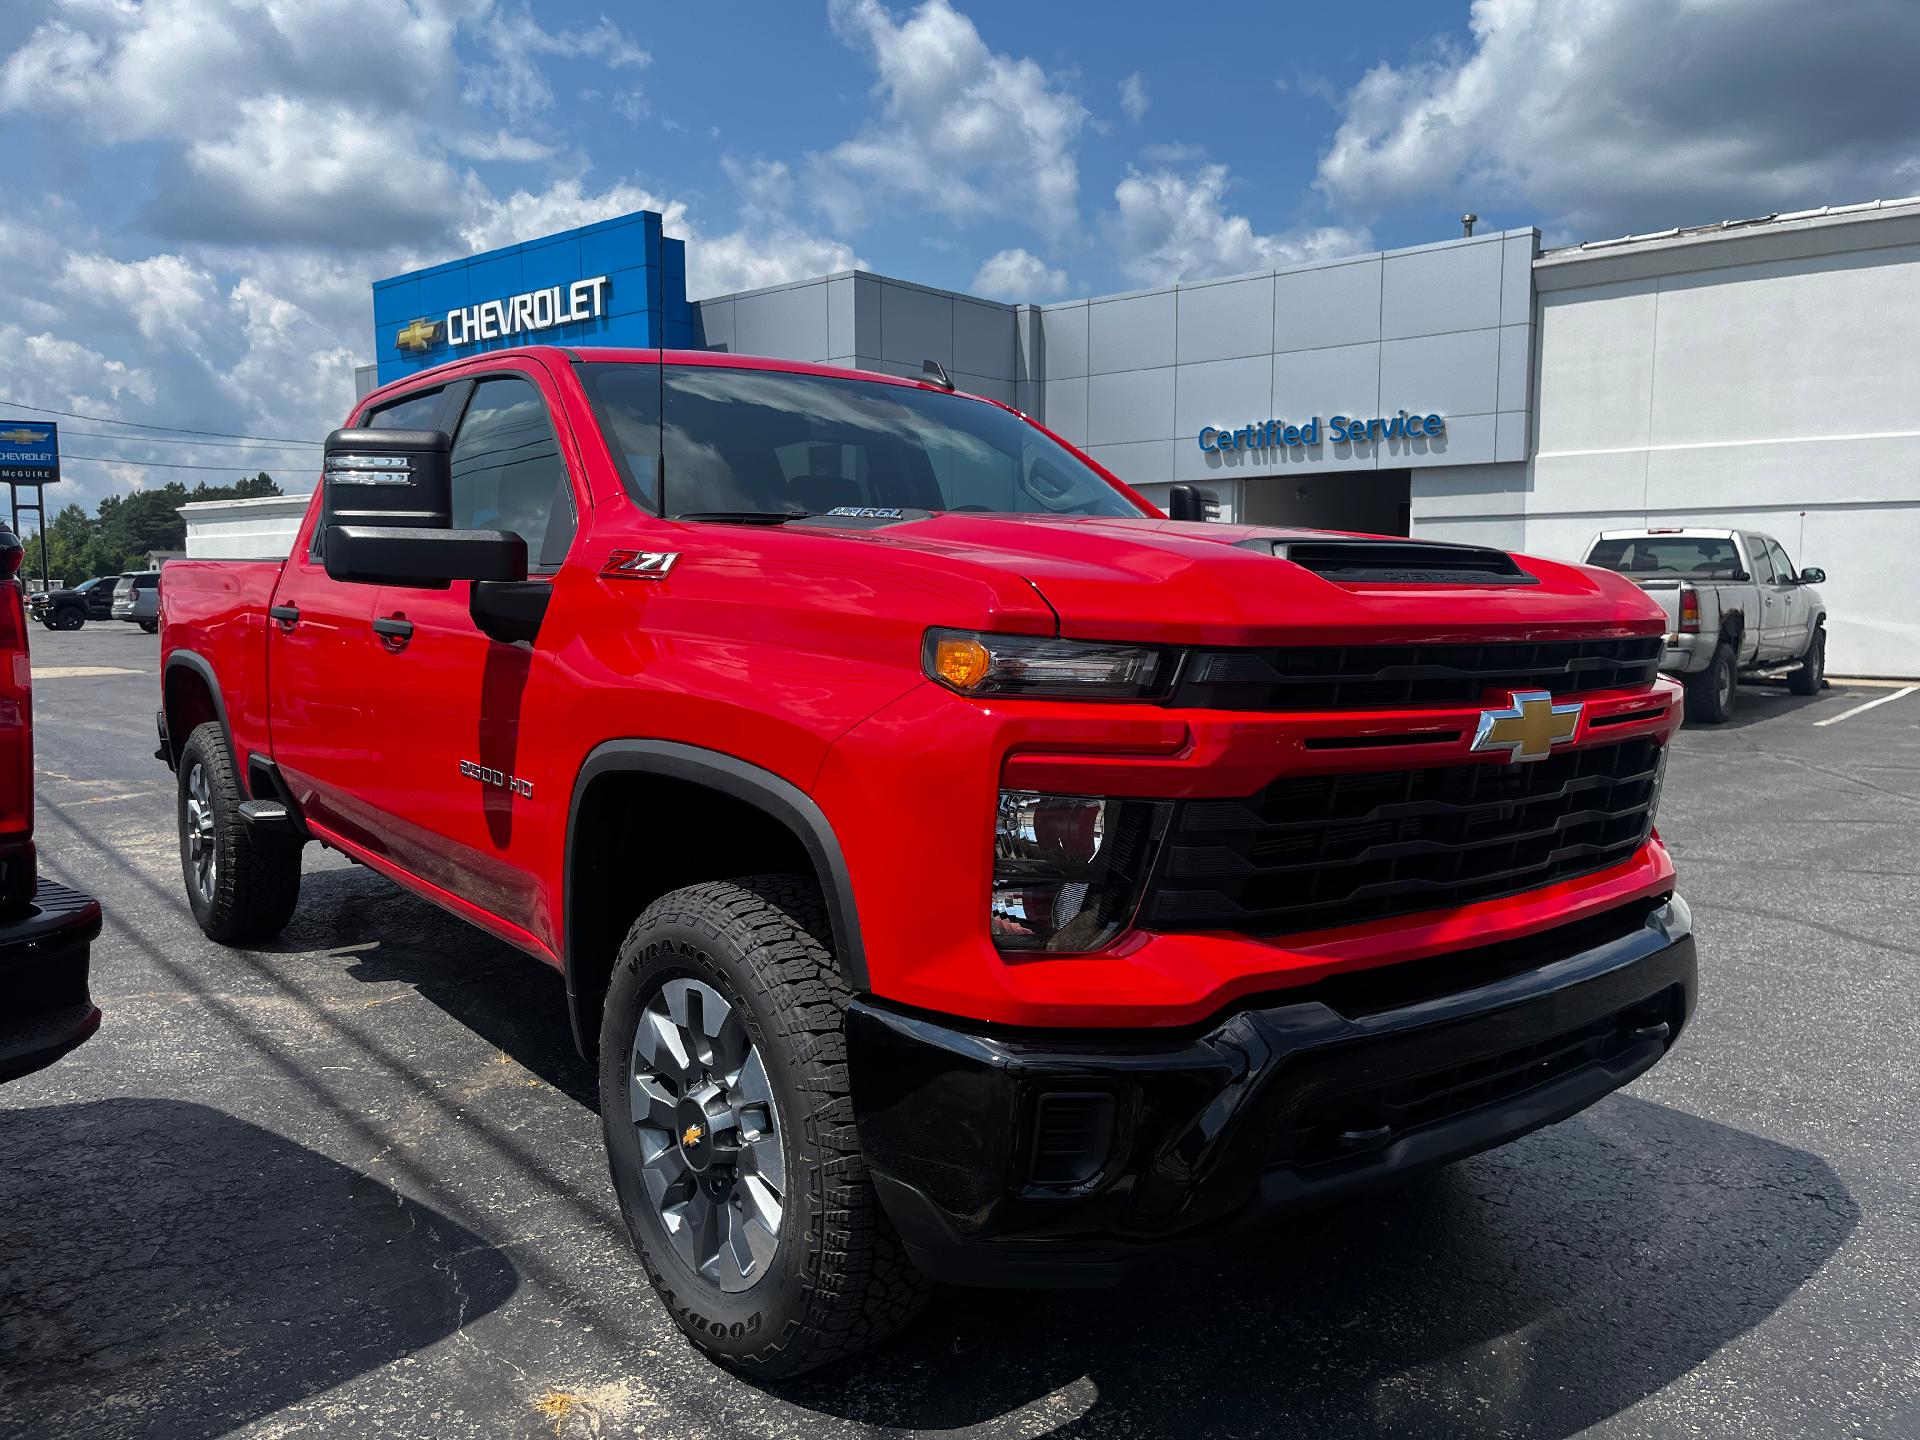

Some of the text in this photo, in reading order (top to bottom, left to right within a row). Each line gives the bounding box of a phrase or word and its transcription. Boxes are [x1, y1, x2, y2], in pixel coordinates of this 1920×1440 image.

[447, 275, 607, 345] CHEVROLET
[1199, 409, 1442, 452] Certified Service
[2, 470, 51, 478] McGUIRE
[601, 550, 679, 575] Z71
[460, 759, 534, 798] 2500 HD
